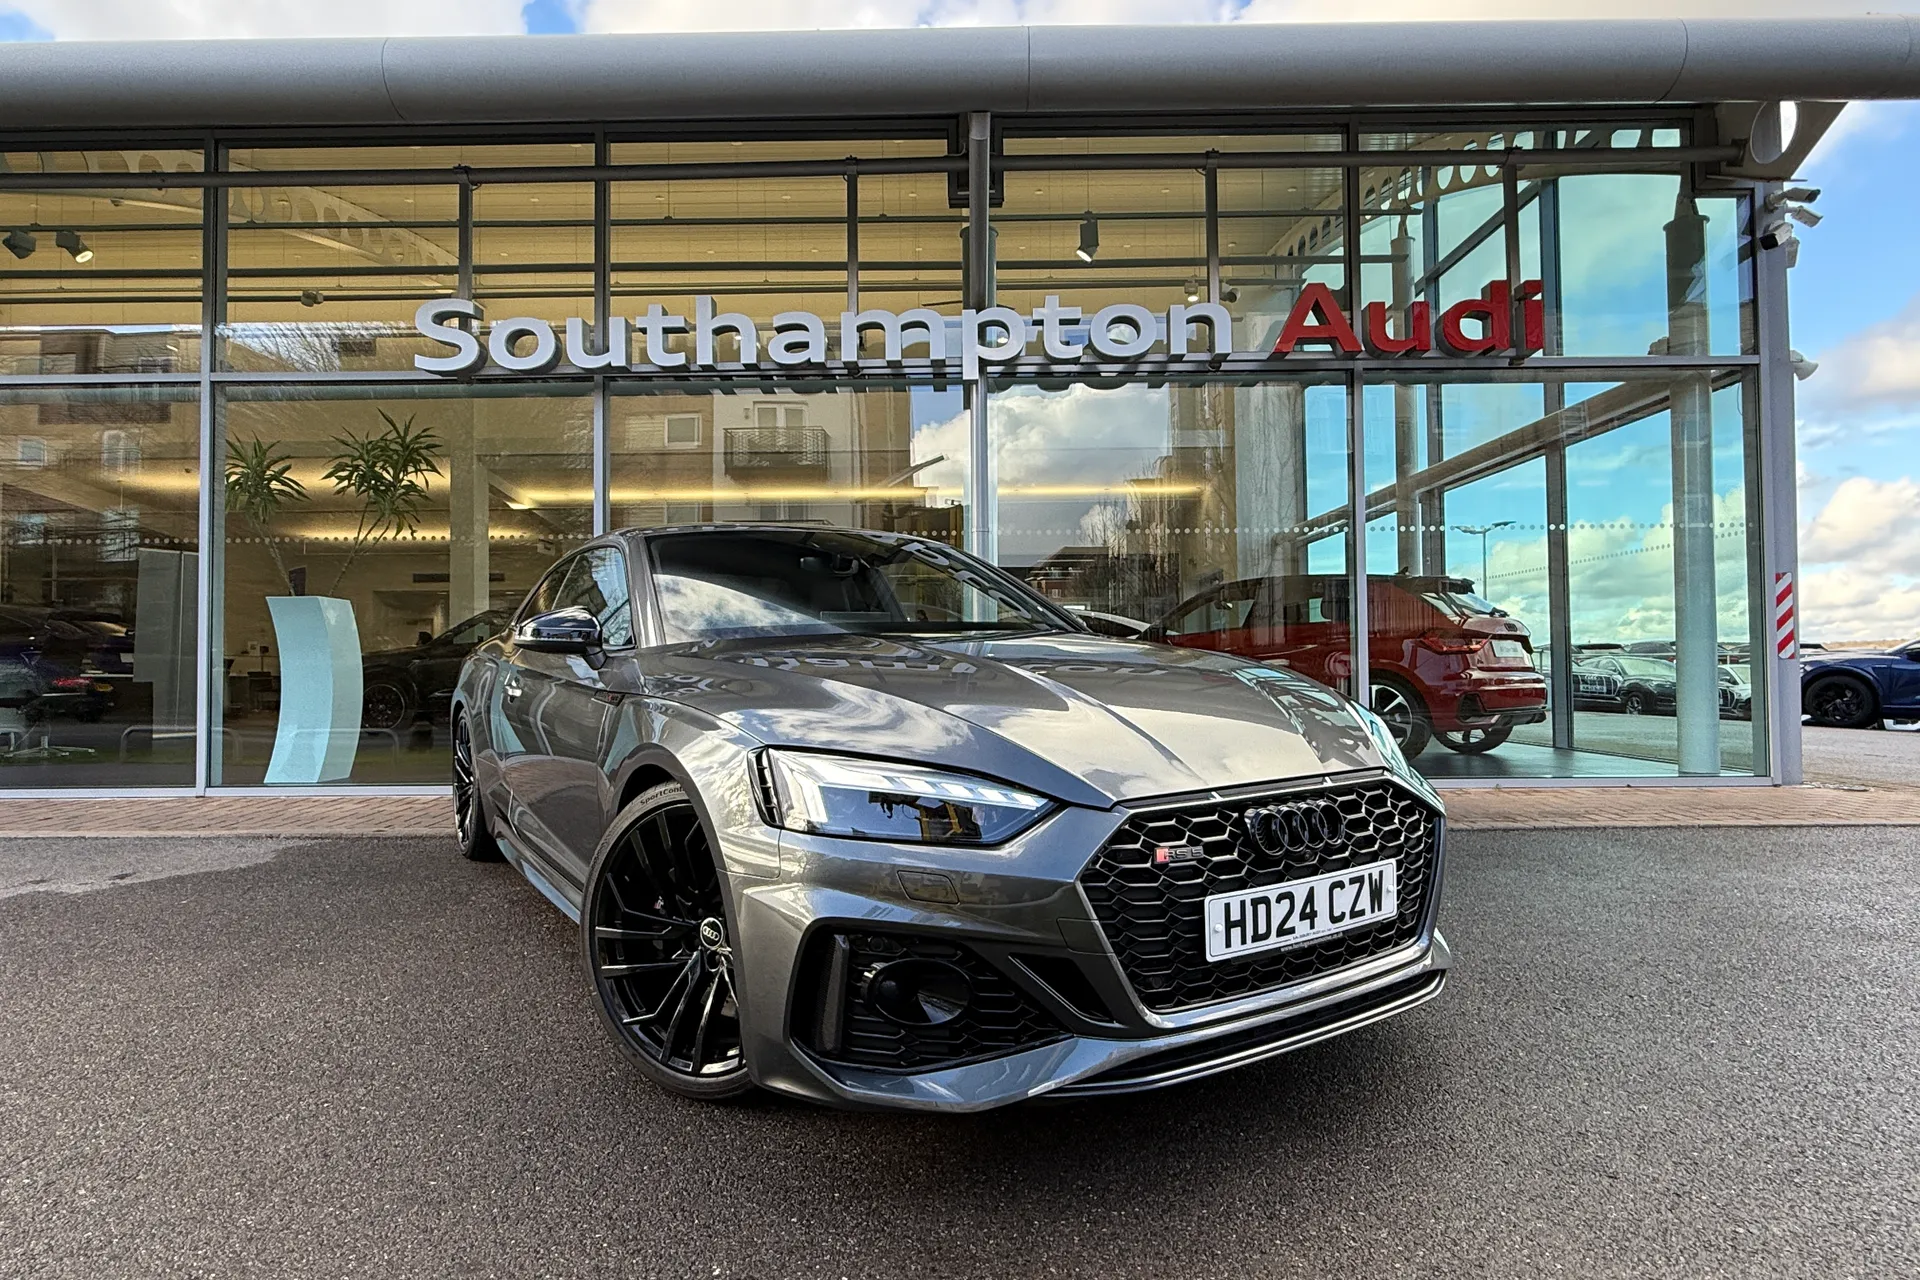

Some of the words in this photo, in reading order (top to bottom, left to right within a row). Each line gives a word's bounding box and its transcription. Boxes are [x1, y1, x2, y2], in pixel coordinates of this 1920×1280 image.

[414, 295, 1232, 380] Southampton
[1274, 279, 1544, 353] Audi
[1223, 885, 1318, 949] HD24
[1328, 869, 1384, 925] CZW
